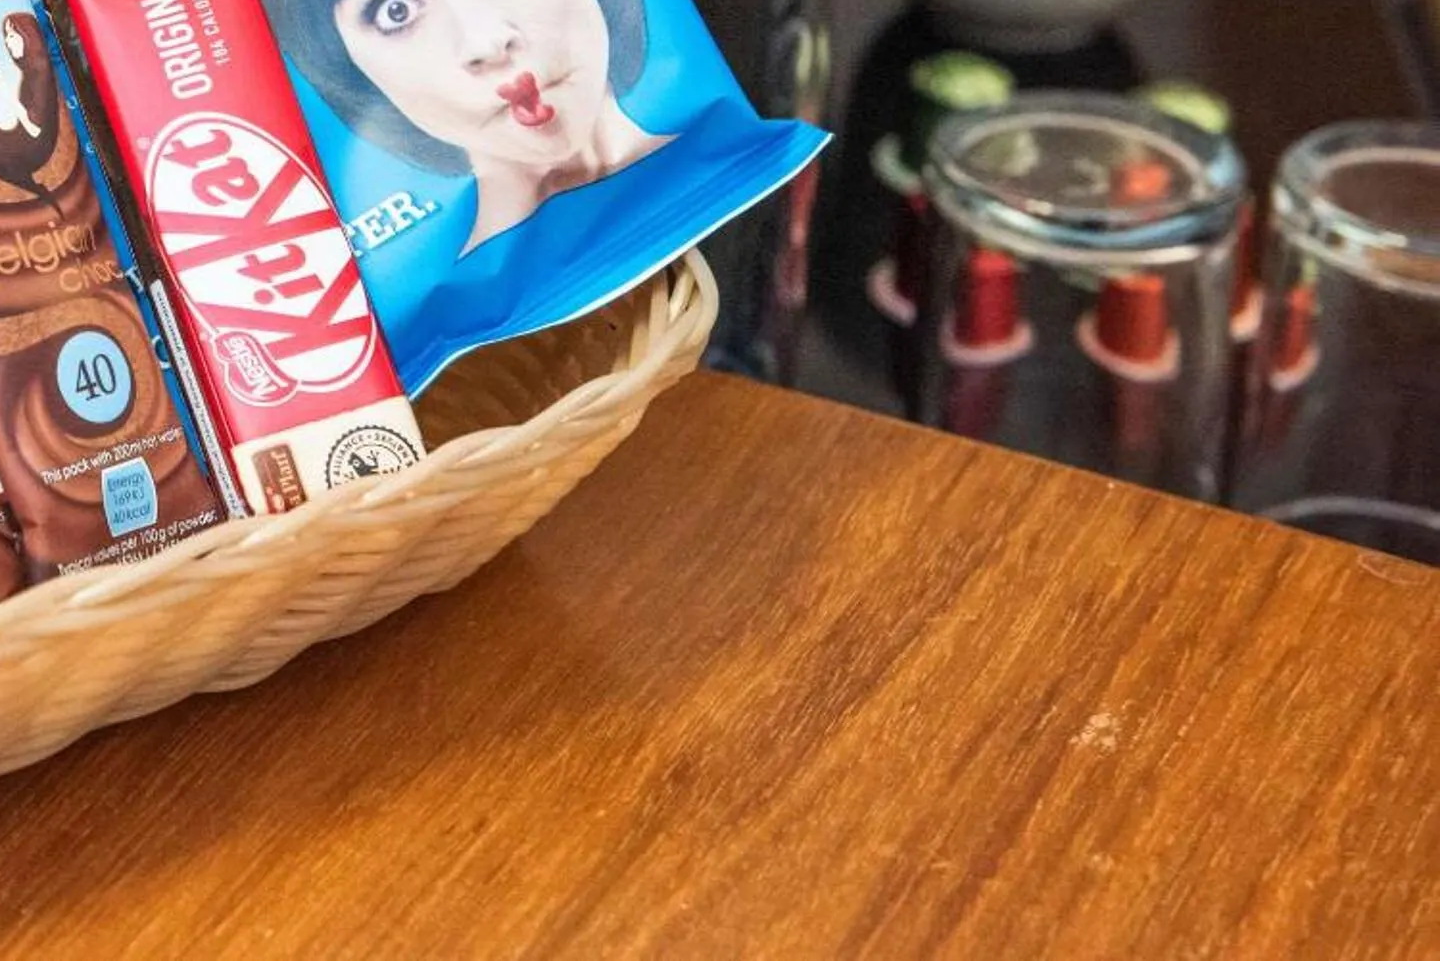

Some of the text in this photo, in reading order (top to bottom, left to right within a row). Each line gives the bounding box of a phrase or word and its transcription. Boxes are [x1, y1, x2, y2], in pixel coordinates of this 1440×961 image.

[158, 129, 372, 362] KitKat
[75, 351, 117, 402] 40
[63, 463, 89, 481] pack
[91, 450, 112, 469] with
[108, 472, 145, 492] Energy
